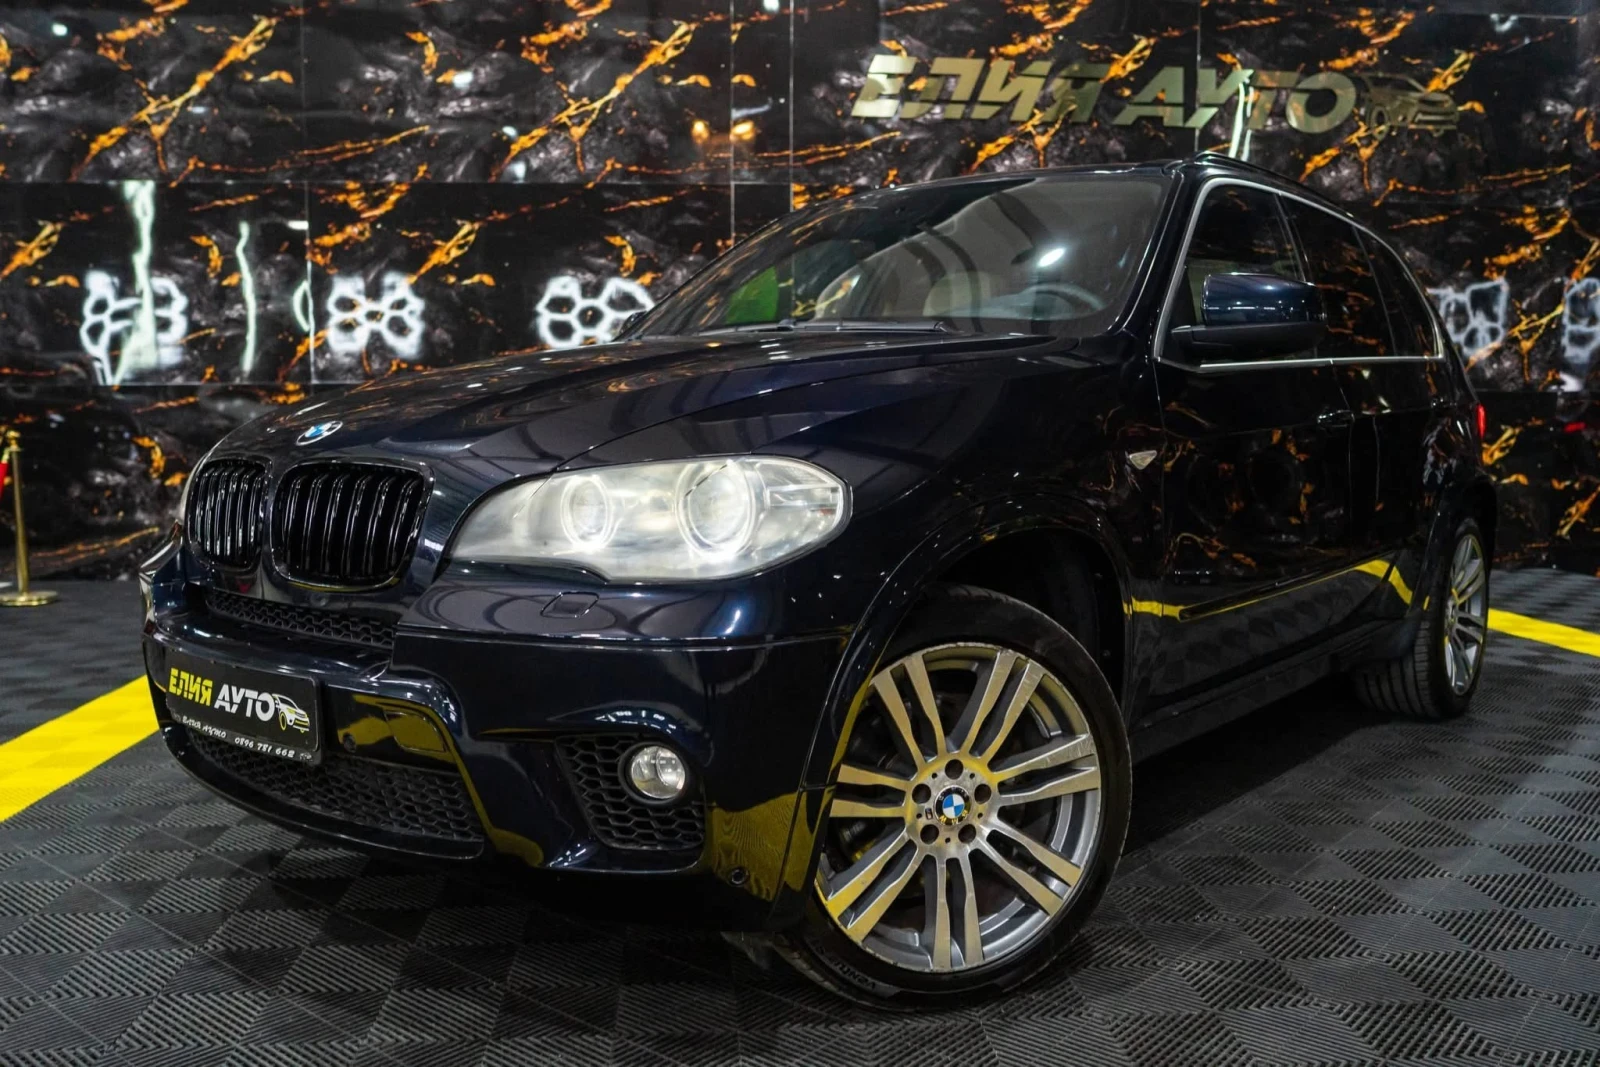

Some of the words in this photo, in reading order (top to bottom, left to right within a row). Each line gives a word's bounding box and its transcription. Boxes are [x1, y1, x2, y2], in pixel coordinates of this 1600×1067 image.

[851, 54, 1110, 123] ЕЛИЯ
[1112, 66, 1357, 134] АУТО
[168, 667, 214, 707] ЕЛИЯ
[213, 683, 276, 722] АУТО
